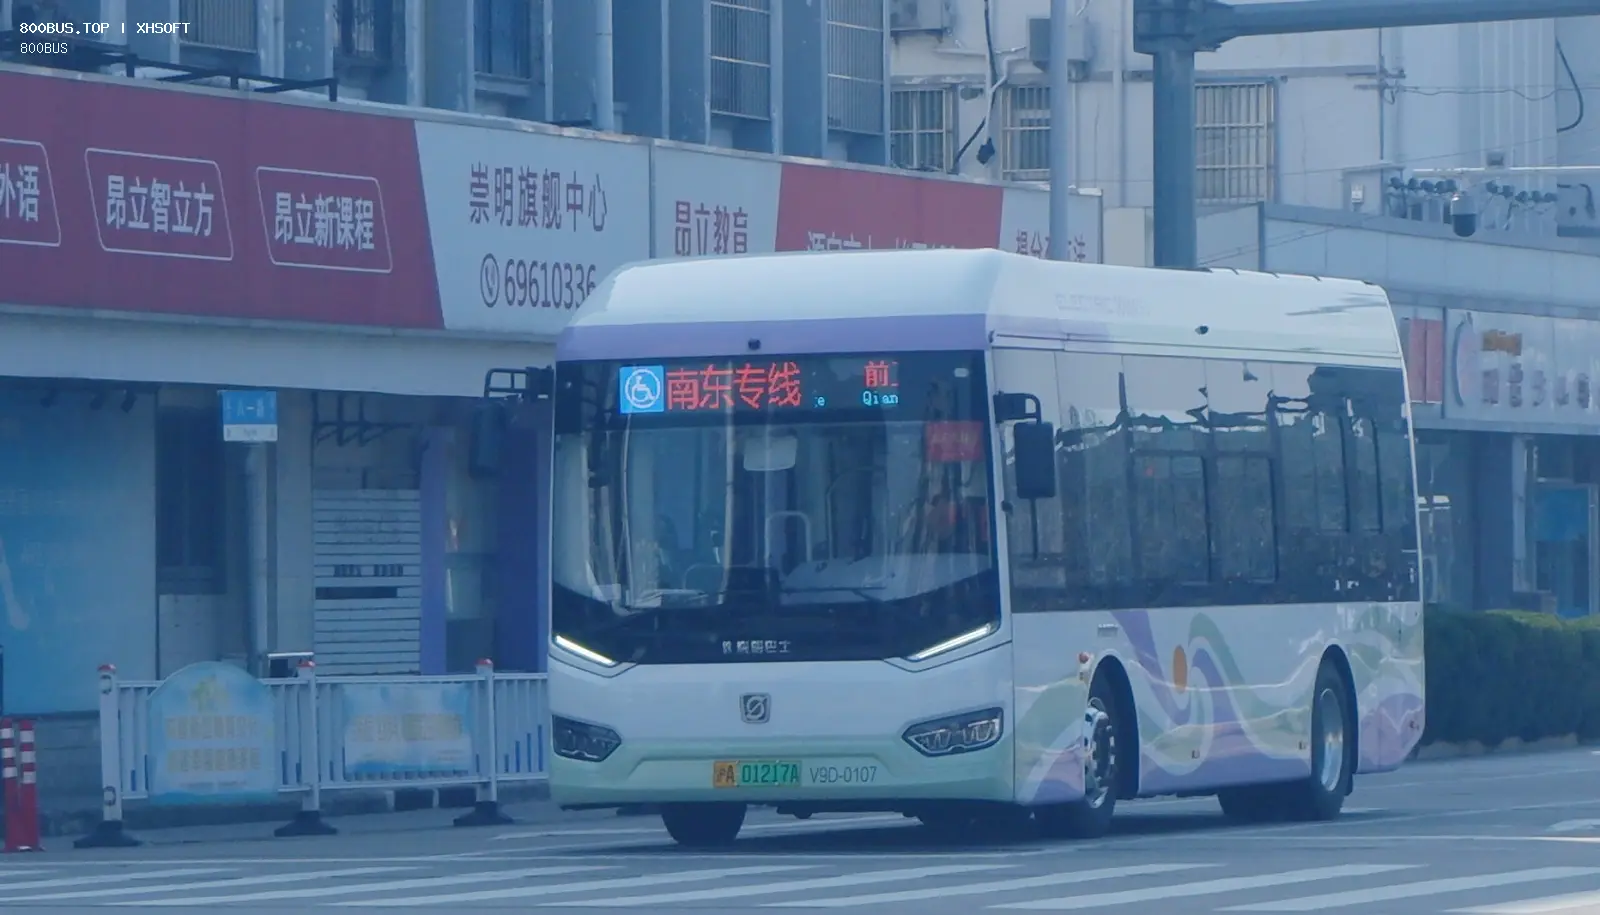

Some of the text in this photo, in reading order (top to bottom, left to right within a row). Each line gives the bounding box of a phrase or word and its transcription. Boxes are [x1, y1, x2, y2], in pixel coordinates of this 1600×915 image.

[106, 174, 215, 237] 昂立智立方
[274, 191, 375, 251] 昂立新课程
[469, 160, 608, 232] 崇明旗舰中心
[675, 200, 749, 256] 昂立教育
[667, 361, 802, 411] 南东专线
[863, 360, 898, 388] 前
[809, 765, 878, 784] V9D-0107
